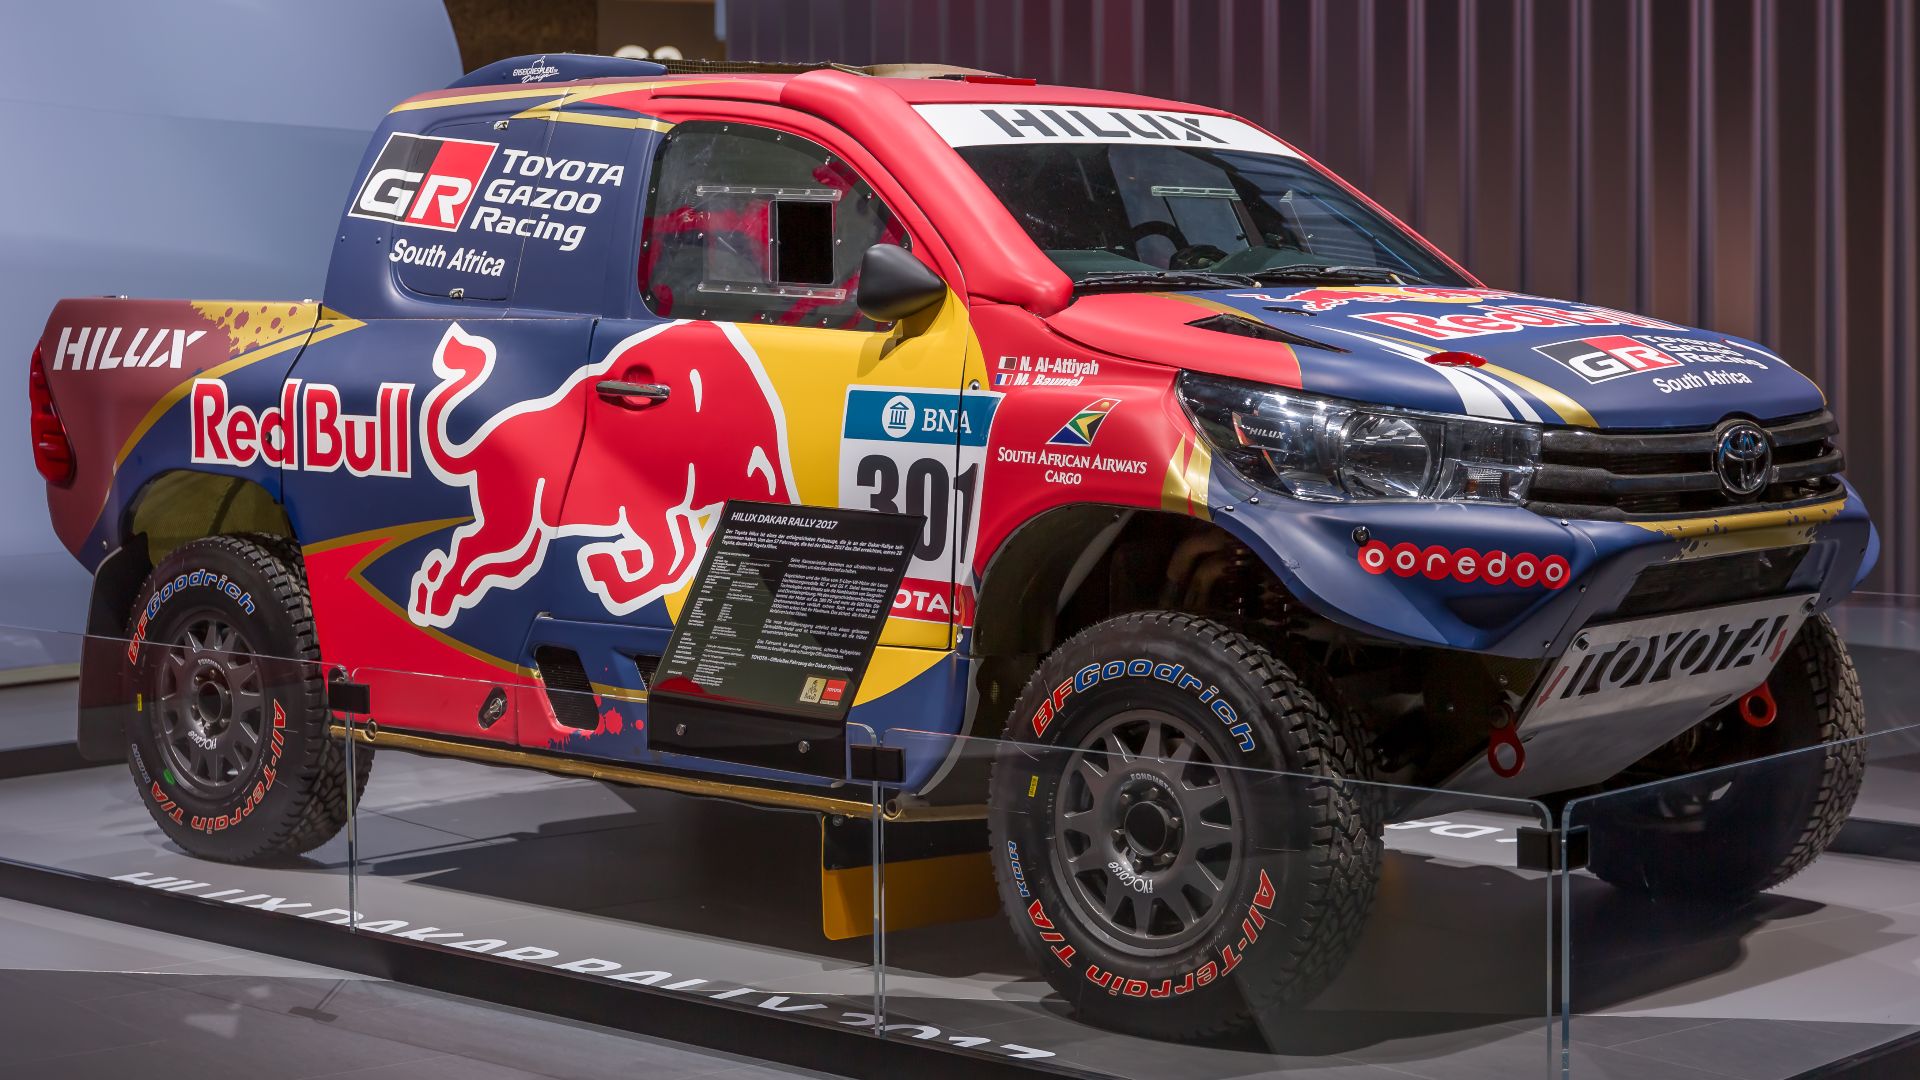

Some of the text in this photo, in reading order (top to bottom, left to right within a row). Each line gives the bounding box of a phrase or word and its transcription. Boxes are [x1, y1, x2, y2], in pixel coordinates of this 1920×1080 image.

[980, 109, 1230, 144] HILUX
[502, 148, 625, 187] TOYOTA
[360, 168, 473, 225] GR
[484, 179, 602, 214] GAZOO
[469, 205, 587, 251] Racing
[388, 238, 506, 277] South Africa
[1349, 304, 1690, 340] Red Bull
[53, 326, 207, 370] HILUX
[1632, 335, 1732, 349] TOYOTA
[1657, 343, 1744, 357] GAZOO
[1020, 356, 1099, 377] N. Al-Attiyah
[1568, 346, 1676, 378] GR
[1675, 352, 1768, 369] Racing
[1014, 373, 1084, 387] M. Baumel
[1653, 370, 1752, 394] South Africa
[190, 378, 415, 478] Red Bull
[921, 408, 971, 434] BNA
[1249, 428, 1286, 439] HILUX
[997, 447, 1147, 474] SOUTH AFRICAN AIRWAYS
[1045, 470, 1082, 485] CARGO
[731, 512, 839, 530] HILUX DAKAR RALLY 2017
[857, 454, 979, 564] 301
[1365, 548, 1563, 581] ooredoo
[128, 569, 255, 666] BFGoodrich
[892, 588, 960, 616] OTAL
[1560, 614, 1790, 699] TOYOTA
[1031, 658, 1256, 753] BFGoodrich
[191, 698, 286, 835] All-Terrain
[152, 781, 184, 825] T/A
[1028, 899, 1077, 968] T/A
[1086, 868, 1276, 998] All-Terrain
